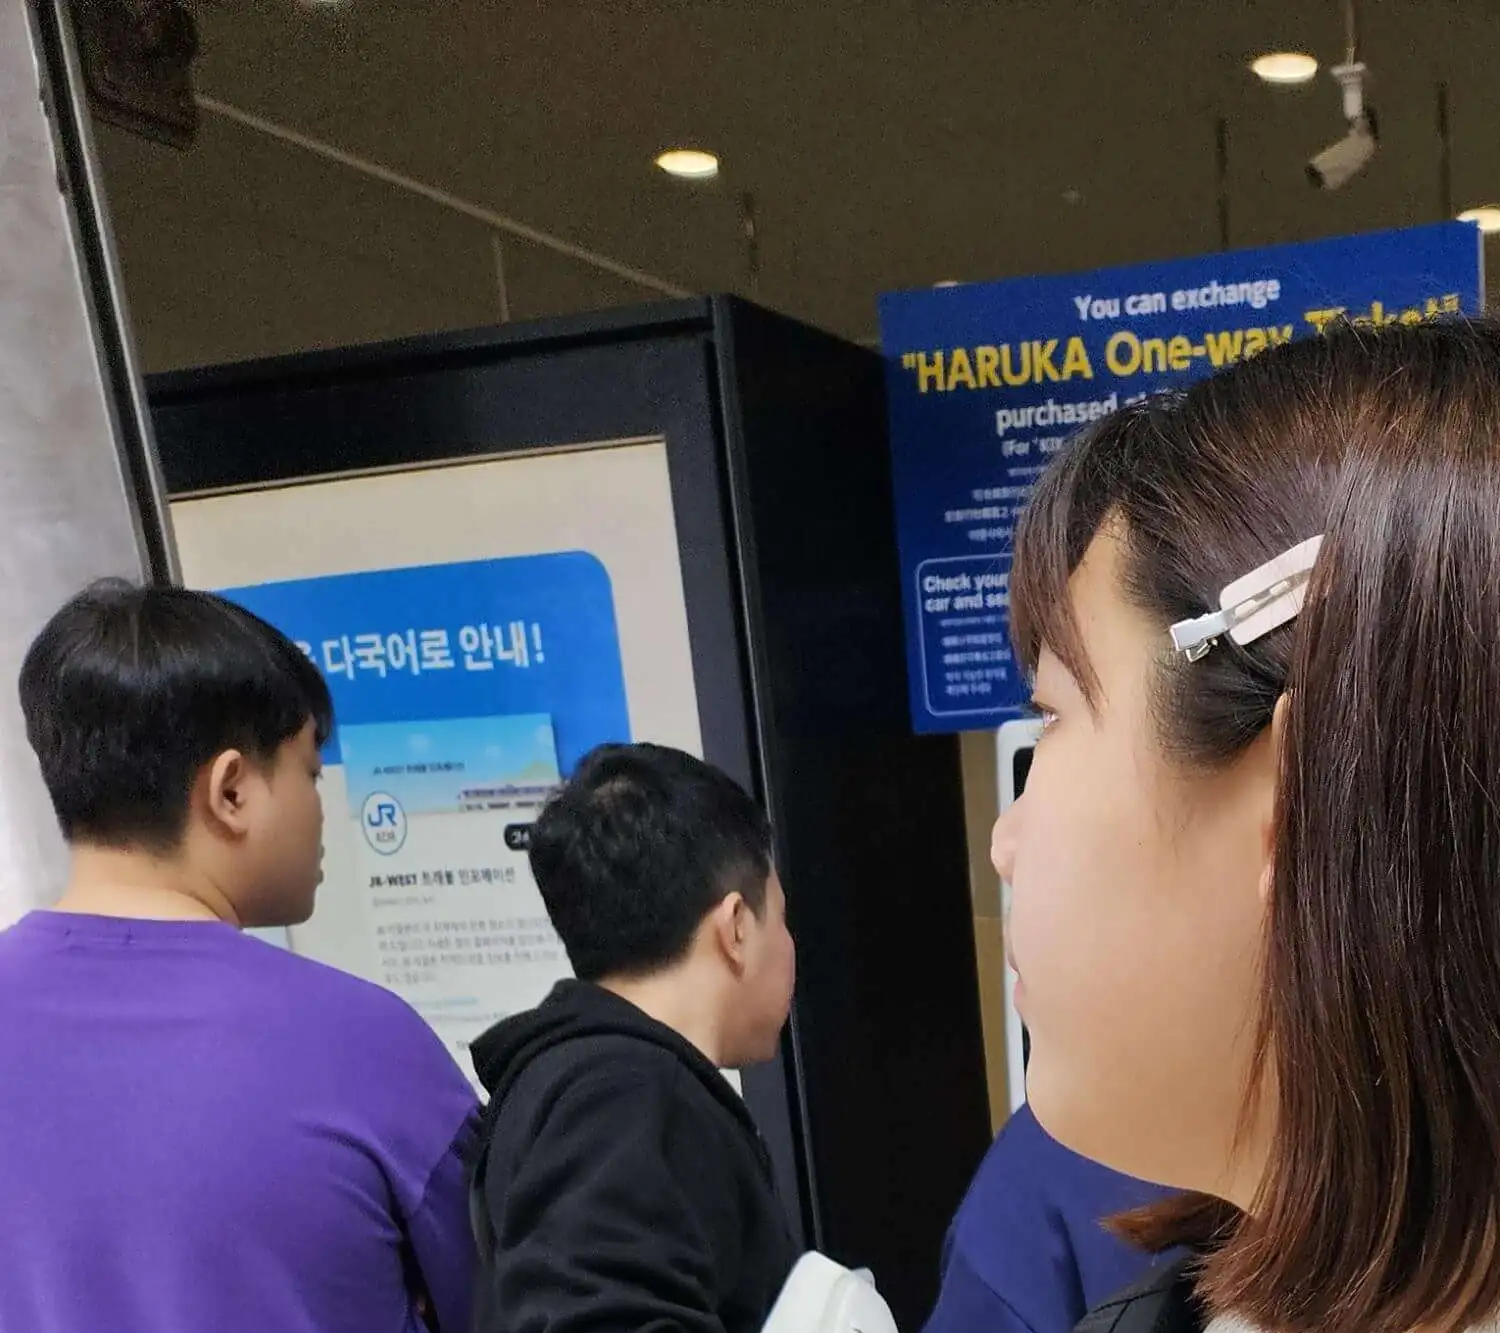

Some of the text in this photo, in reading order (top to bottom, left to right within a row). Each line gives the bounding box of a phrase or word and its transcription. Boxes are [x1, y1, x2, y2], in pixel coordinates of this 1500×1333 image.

[1074, 278, 1281, 322] You can exchange
[902, 335, 1094, 394] "HARUKA
[995, 394, 1119, 437] purchased
[923, 573, 972, 593] Check
[924, 597, 951, 614] car
[953, 592, 984, 611] and
[322, 620, 546, 681] 다국어로 안내!
[367, 803, 398, 827] JR
